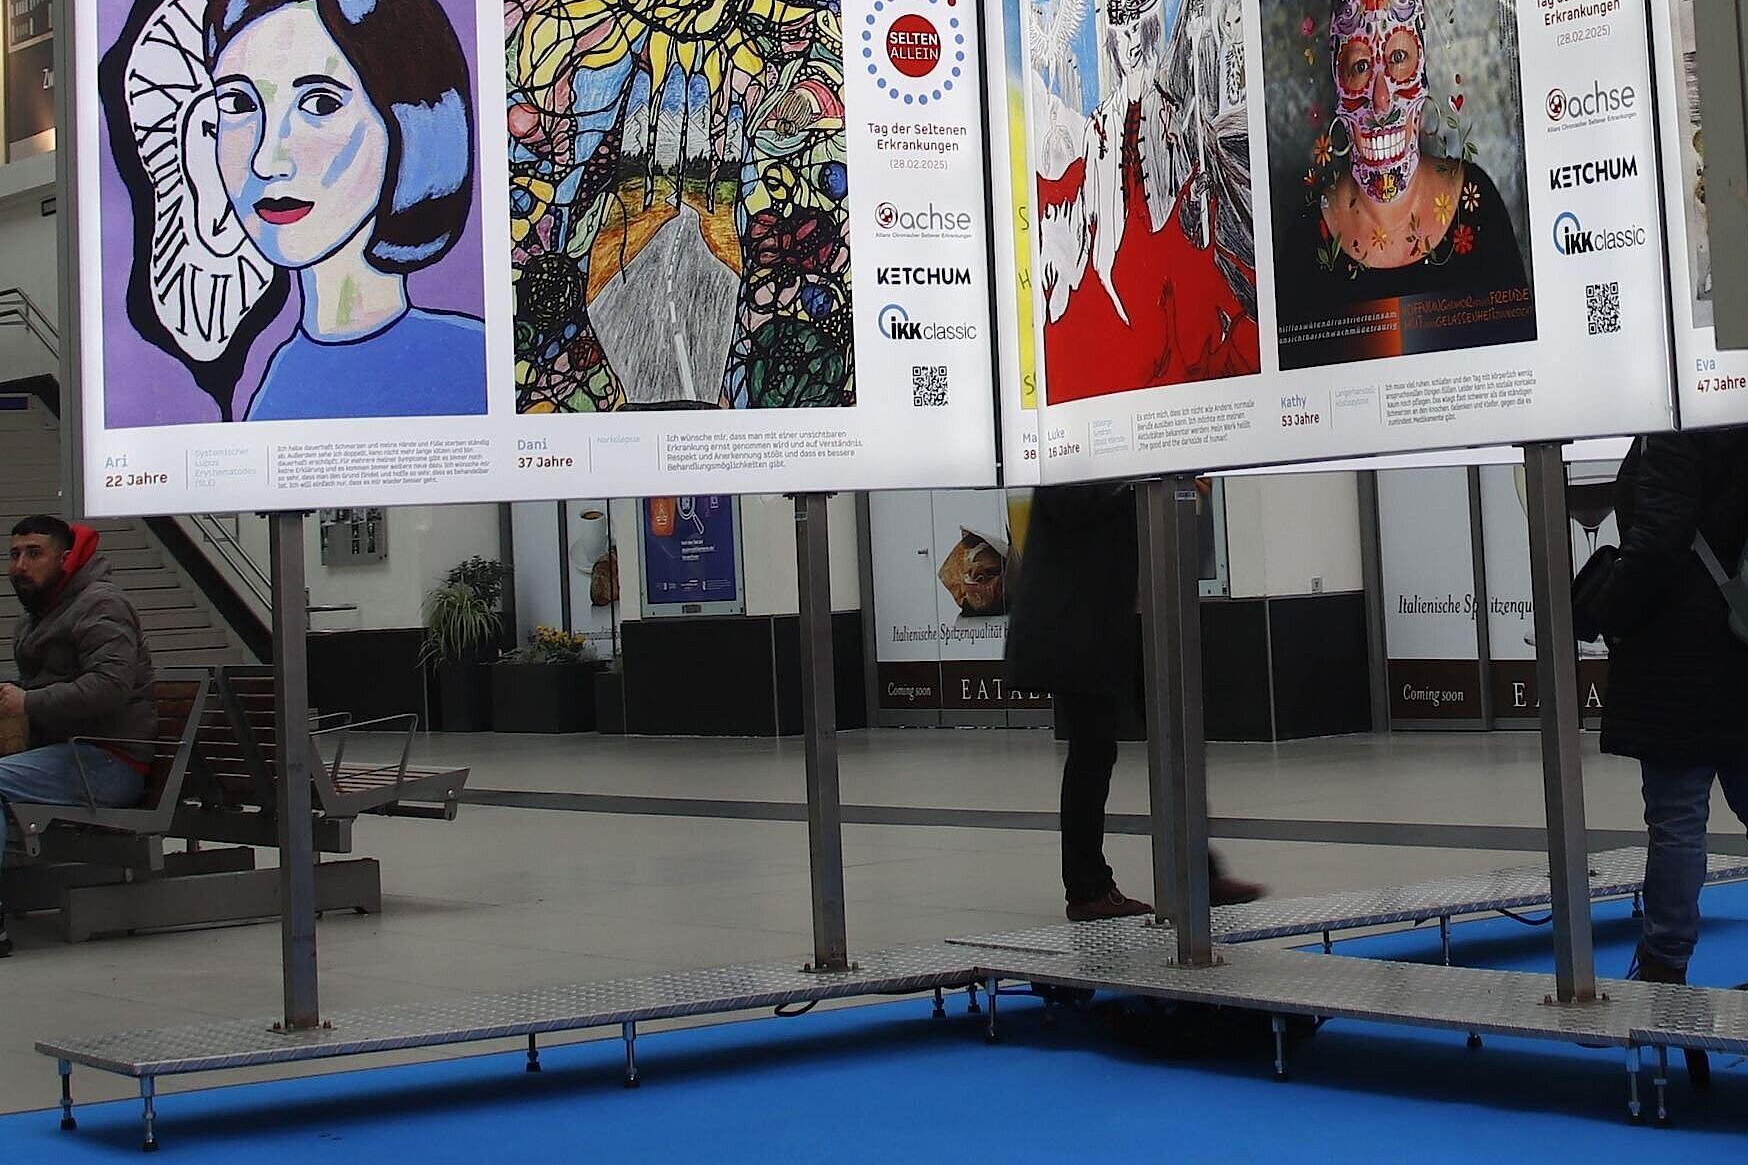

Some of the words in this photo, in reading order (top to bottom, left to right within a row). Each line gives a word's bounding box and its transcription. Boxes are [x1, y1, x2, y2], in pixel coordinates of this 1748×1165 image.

[890, 32, 938, 46] SELTEN
[1556, 24, 1611, 46] (28.02.2025)
[890, 47, 938, 60] ALLEIN
[1568, 80, 1635, 118] achse
[868, 123, 888, 136] Tag
[891, 123, 911, 134] der
[914, 124, 967, 135] Seltenen
[877, 139, 959, 153] Erkrankungen
[890, 160, 948, 170] (28.02.2025)
[1550, 155, 1638, 190] KETCHUM
[900, 203, 970, 230] achse
[1594, 223, 1646, 251] classic
[878, 268, 971, 284] KETCHUM
[924, 324, 976, 340] classic
[1696, 358, 1716, 371] Eva
[1697, 378, 1712, 392] 47
[1714, 375, 1746, 390] Jahre
[1281, 394, 1307, 409] Kathy
[1282, 416, 1292, 427] 53
[1294, 413, 1320, 426] Jahre
[1048, 428, 1064, 441] Luke
[517, 438, 547, 451] Dani
[1049, 448, 1057, 458] 16
[1059, 442, 1080, 456] Jahre
[105, 456, 128, 469] Ari
[518, 457, 533, 468] 37
[536, 455, 573, 468] Jahre
[1024, 450, 1037, 460] 38
[667, 460, 767, 472] Behandlungsmöglichkeiten
[768, 460, 785, 469] gibt.
[106, 474, 123, 488] 22
[127, 472, 168, 486] Jahre
[1399, 594, 1460, 614] Italienische
[893, 625, 937, 642] Italienische
[940, 623, 1002, 646] Spitzenqualität
[888, 682, 914, 700] Coming
[915, 686, 931, 696] soon
[1403, 684, 1440, 706] Coming
[1442, 690, 1464, 702] soon
